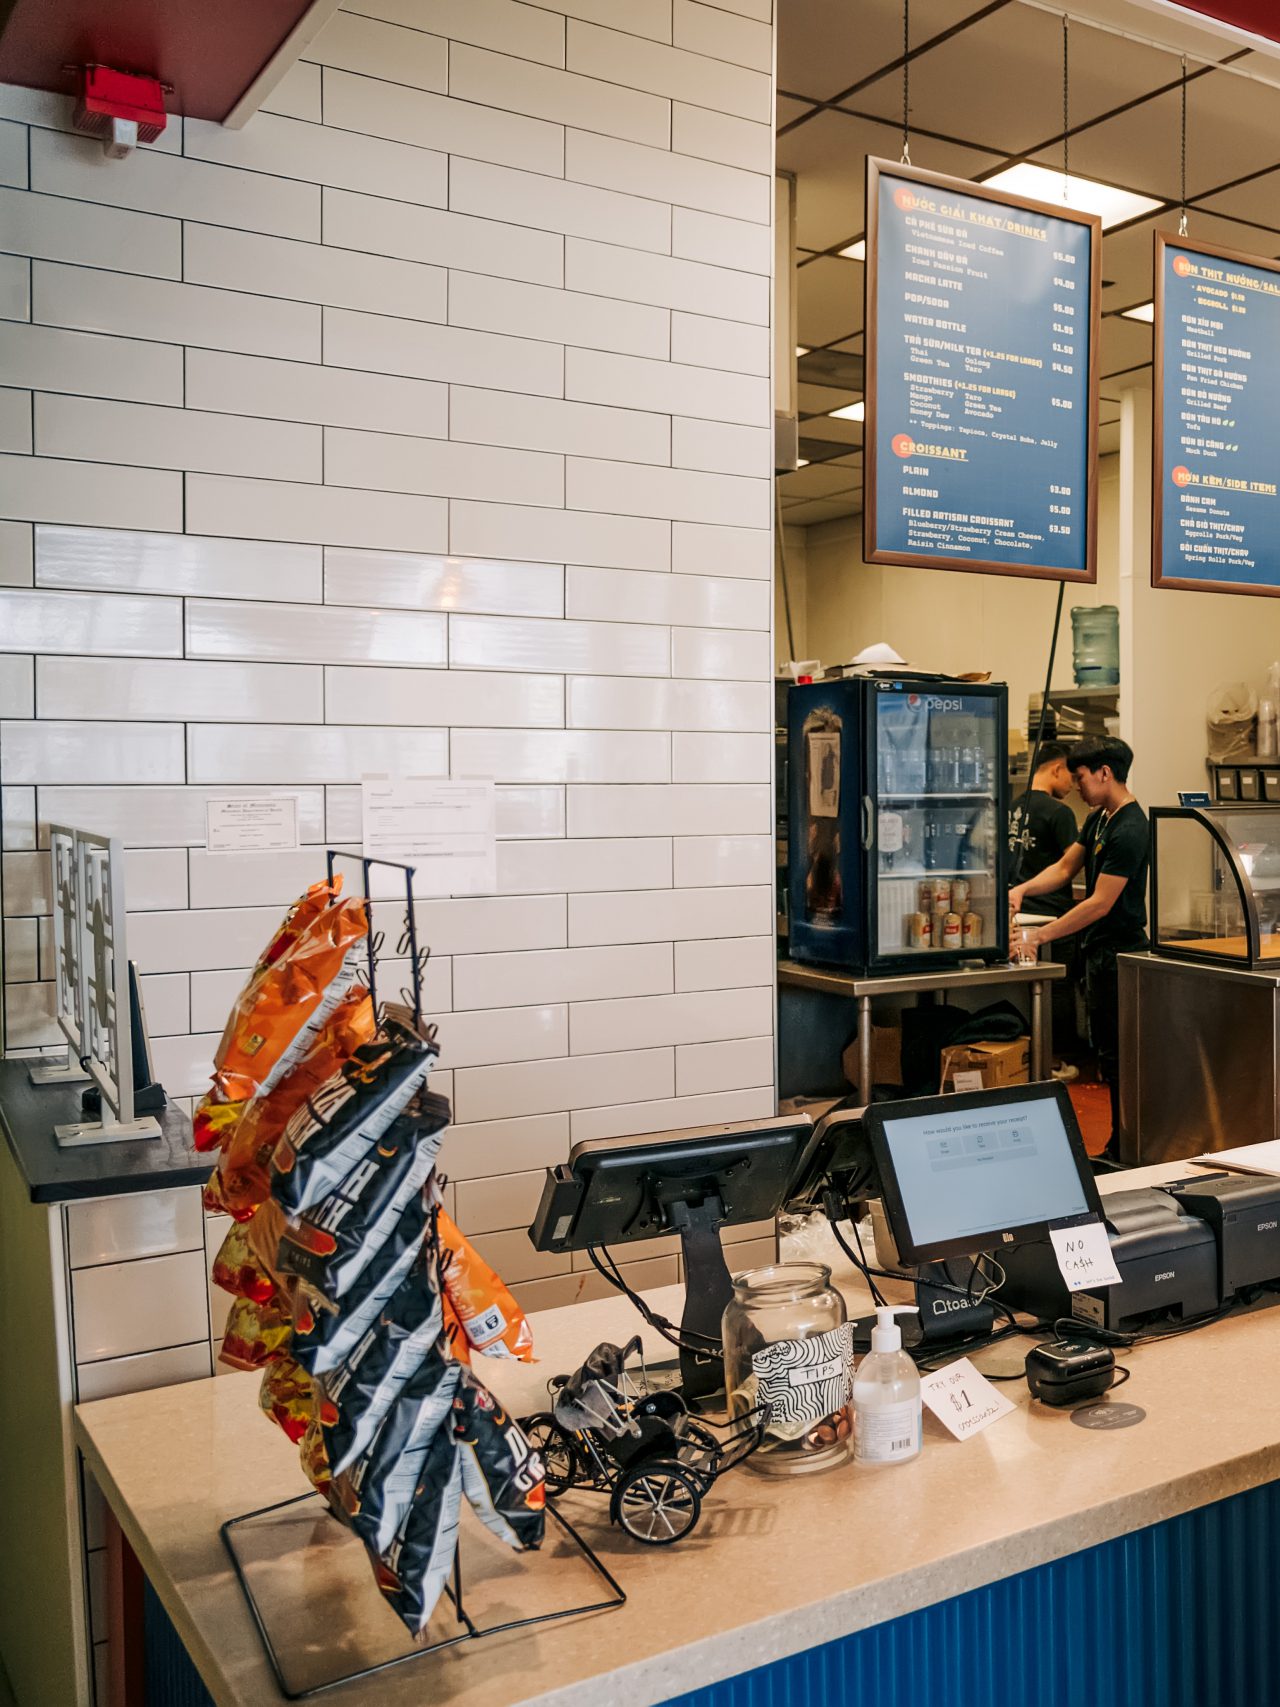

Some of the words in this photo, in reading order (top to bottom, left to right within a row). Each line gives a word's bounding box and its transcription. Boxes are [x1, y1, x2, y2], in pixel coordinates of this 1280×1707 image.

[905, 292, 949, 308] POP/SODA
[904, 314, 934, 326] WATER
[936, 320, 966, 332] BOTTLE
[910, 347, 928, 356] Thai
[965, 357, 990, 368] Oolong
[966, 346, 981, 356] TEA
[910, 355, 933, 364] Green
[965, 365, 982, 373] Taro
[904, 372, 952, 387] SMOOTHIES
[910, 384, 954, 398] Strawberry
[965, 393, 982, 401] Taro
[910, 392, 932, 402] Mango
[965, 401, 986, 409] Green
[989, 404, 1002, 412] Tea
[910, 400, 941, 410] Coconut
[965, 408, 994, 418] Avocado
[910, 407, 932, 418] Honey
[900, 441, 968, 460] CROISSANT
[1040, 440, 1057, 448] Jelly
[903, 466, 928, 476] PLAIN
[903, 486, 938, 498] ALMOND
[1250, 482, 1276, 494] ITEMS
[903, 508, 931, 518] FILLED
[933, 511, 968, 522] ARTISAN
[970, 515, 1014, 527] CROISSANT
[908, 539, 934, 547] Raisin
[937, 542, 970, 551] Cinnamon
[924, 698, 962, 712] pepsi
[1257, 1221, 1277, 1231] EPSON
[1066, 1240, 1084, 1252] NO
[1154, 1272, 1174, 1282] EPSON
[803, 1364, 834, 1382] TIPS
[950, 1390, 974, 1412] $1
